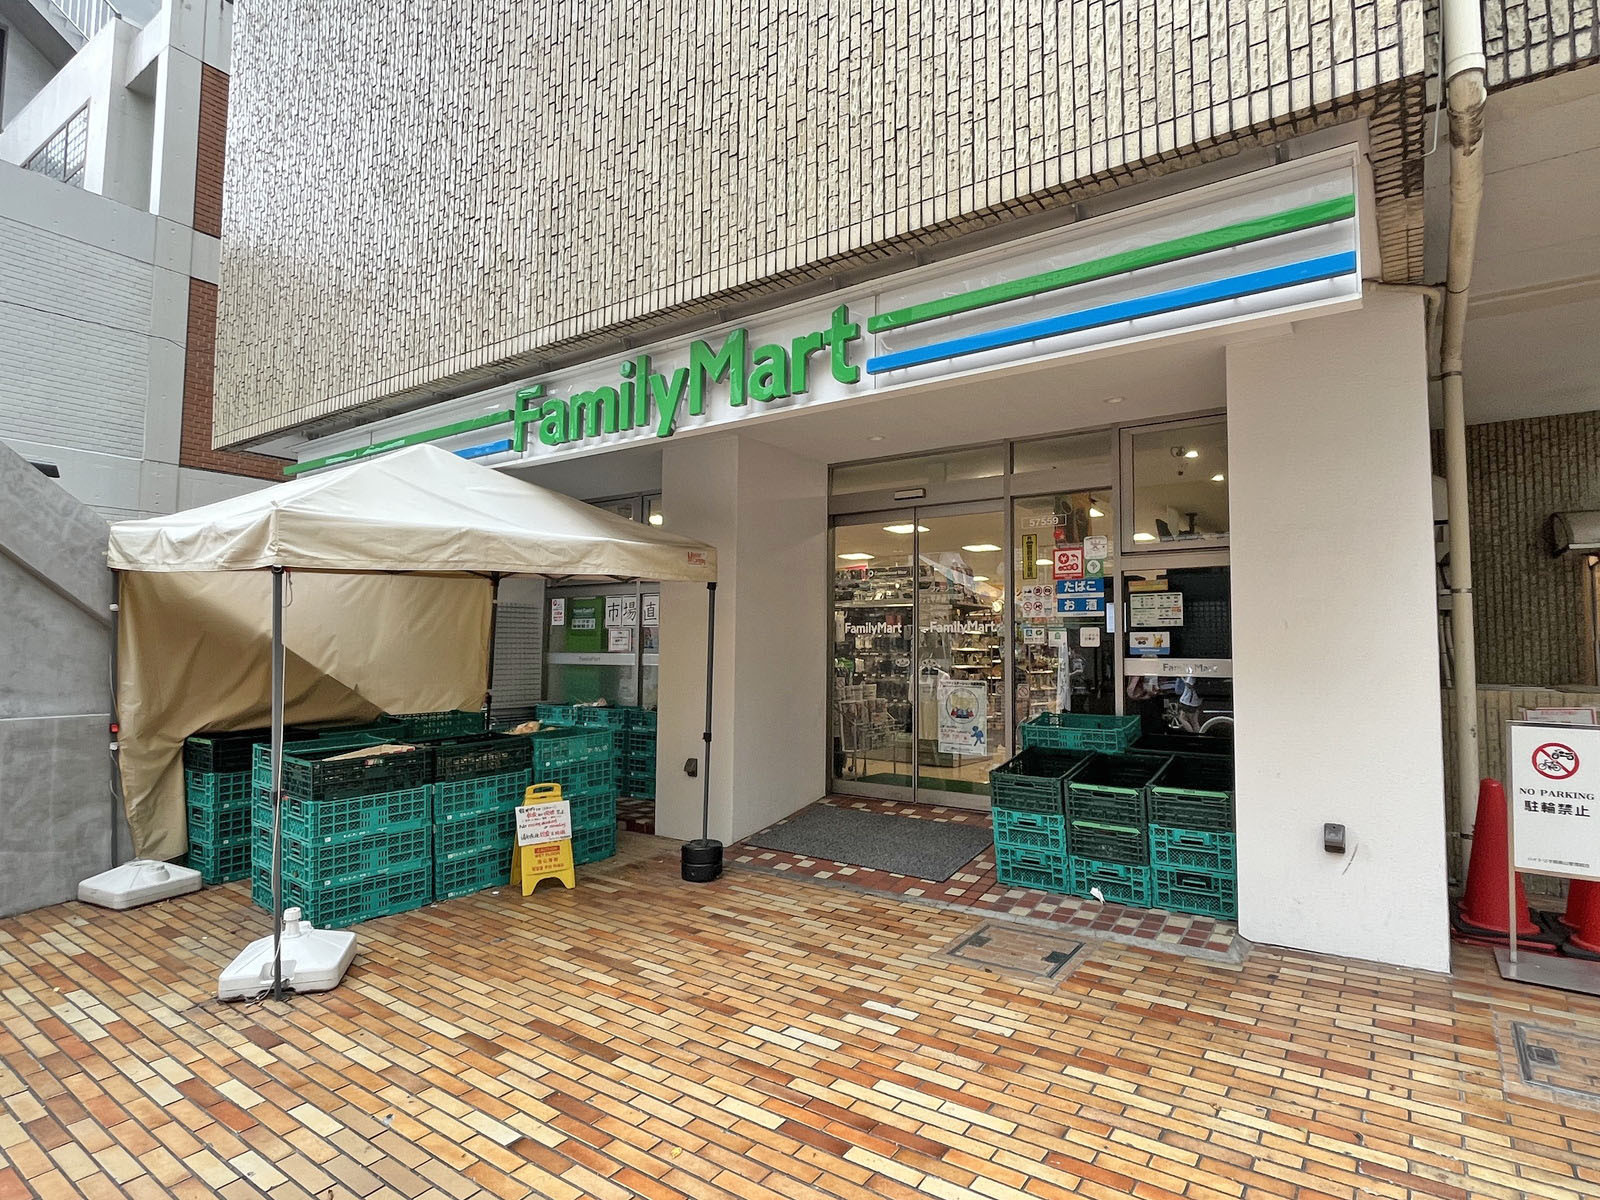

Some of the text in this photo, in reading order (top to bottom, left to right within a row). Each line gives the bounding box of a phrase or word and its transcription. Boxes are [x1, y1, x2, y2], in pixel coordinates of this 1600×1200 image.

[513, 303, 861, 452] FamilyMart
[1029, 516, 1059, 527] 57559
[1064, 580, 1097, 592] たばこ
[845, 621, 903, 635] FamilyMart
[929, 619, 996, 634] FamilyMart
[1519, 787, 1595, 801] NO PARKING
[1524, 800, 1591, 818] 駐輪禁止
